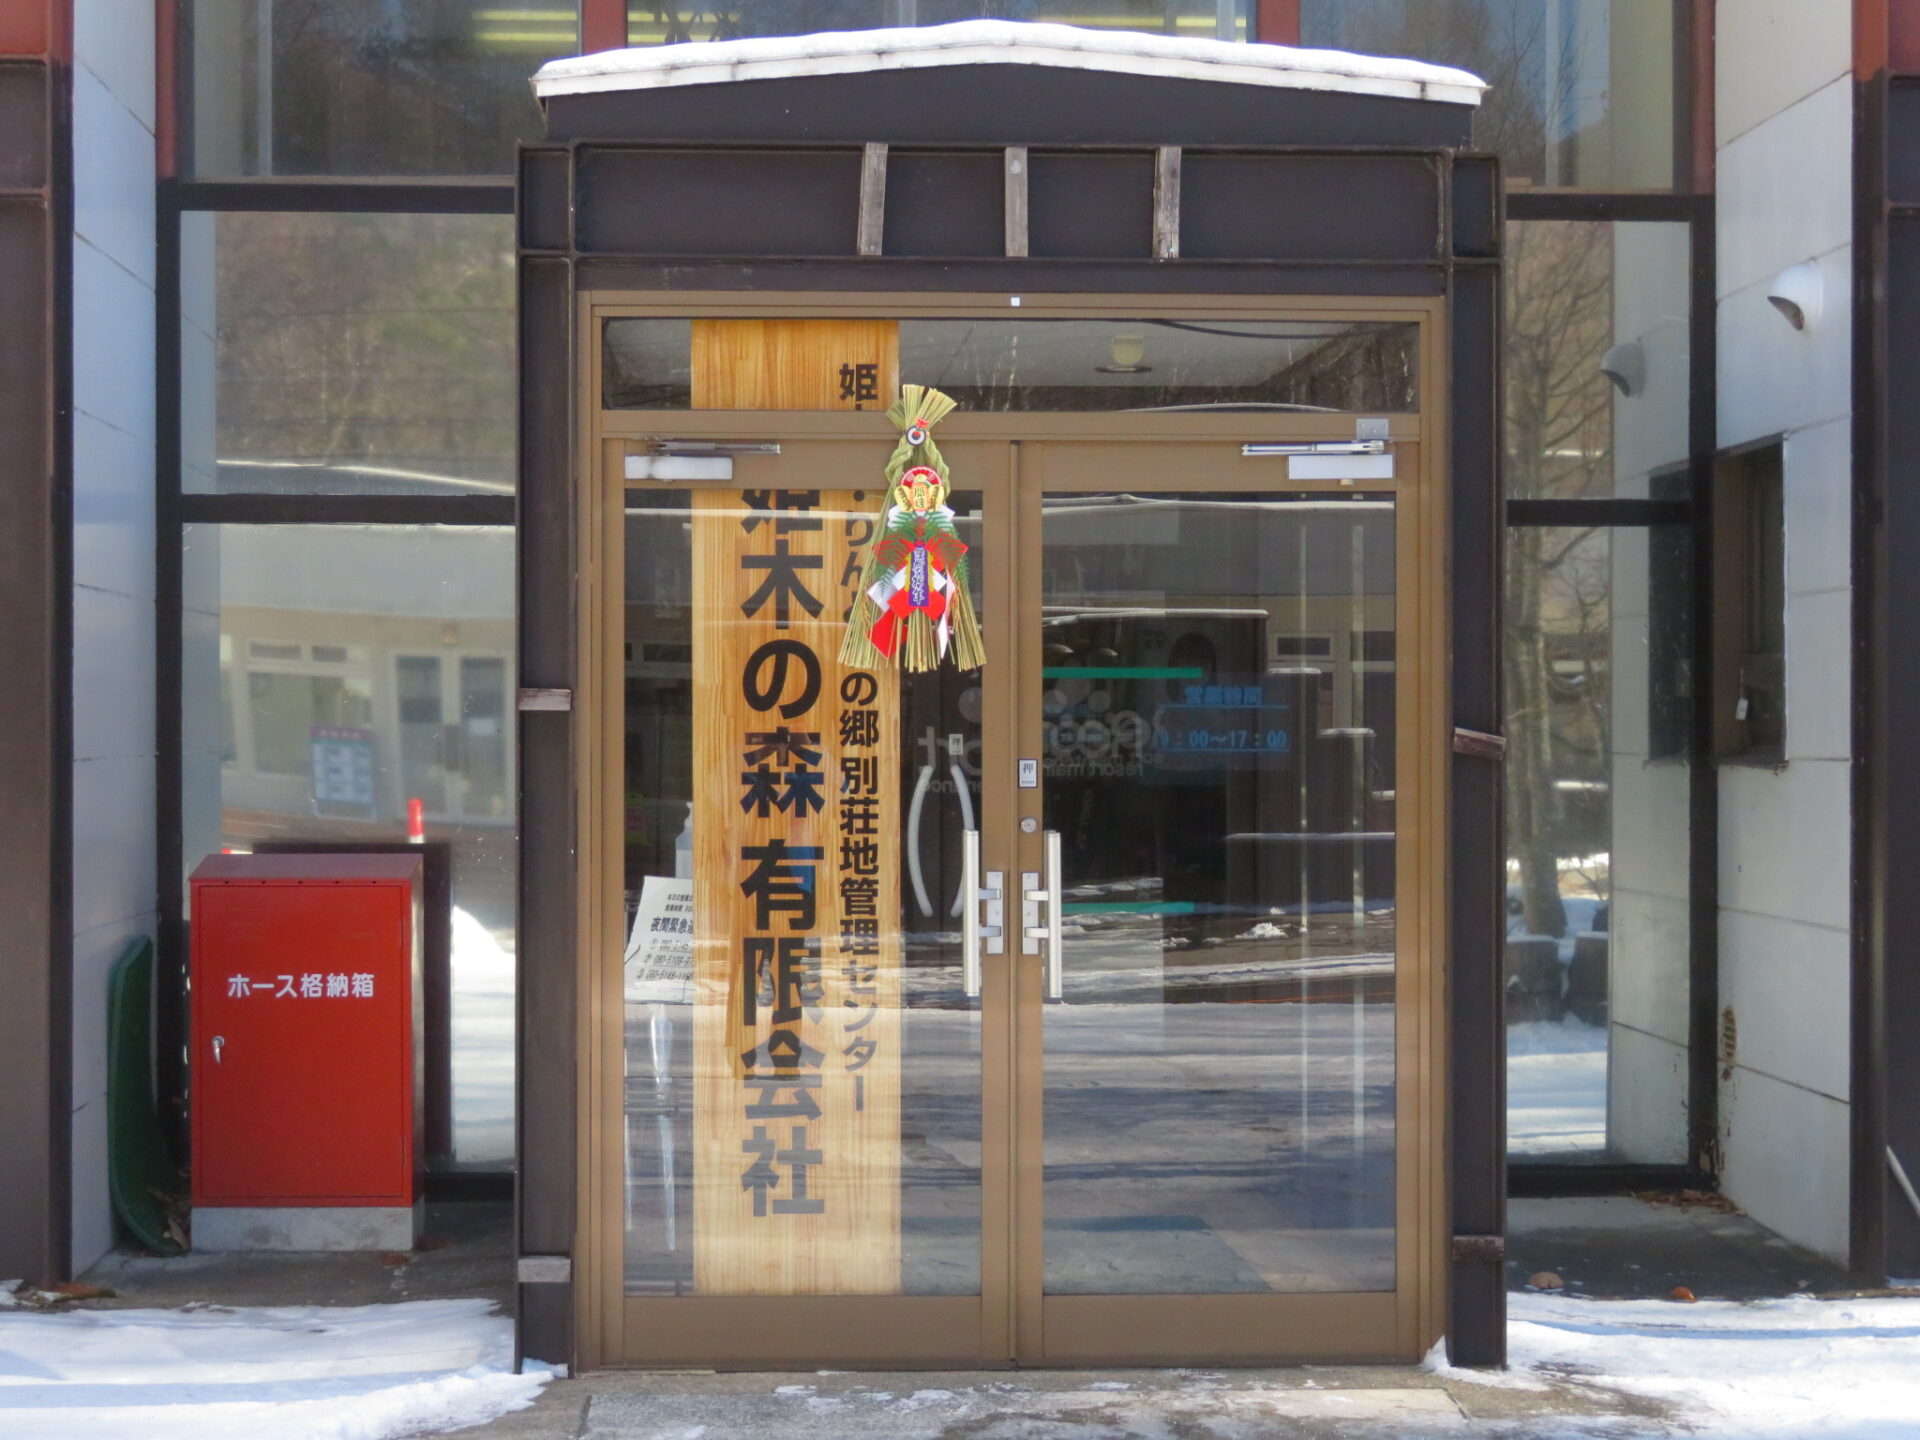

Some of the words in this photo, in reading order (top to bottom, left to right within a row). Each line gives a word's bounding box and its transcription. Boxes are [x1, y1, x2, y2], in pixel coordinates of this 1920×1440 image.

[228, 973, 375, 998] ホース格納箱
